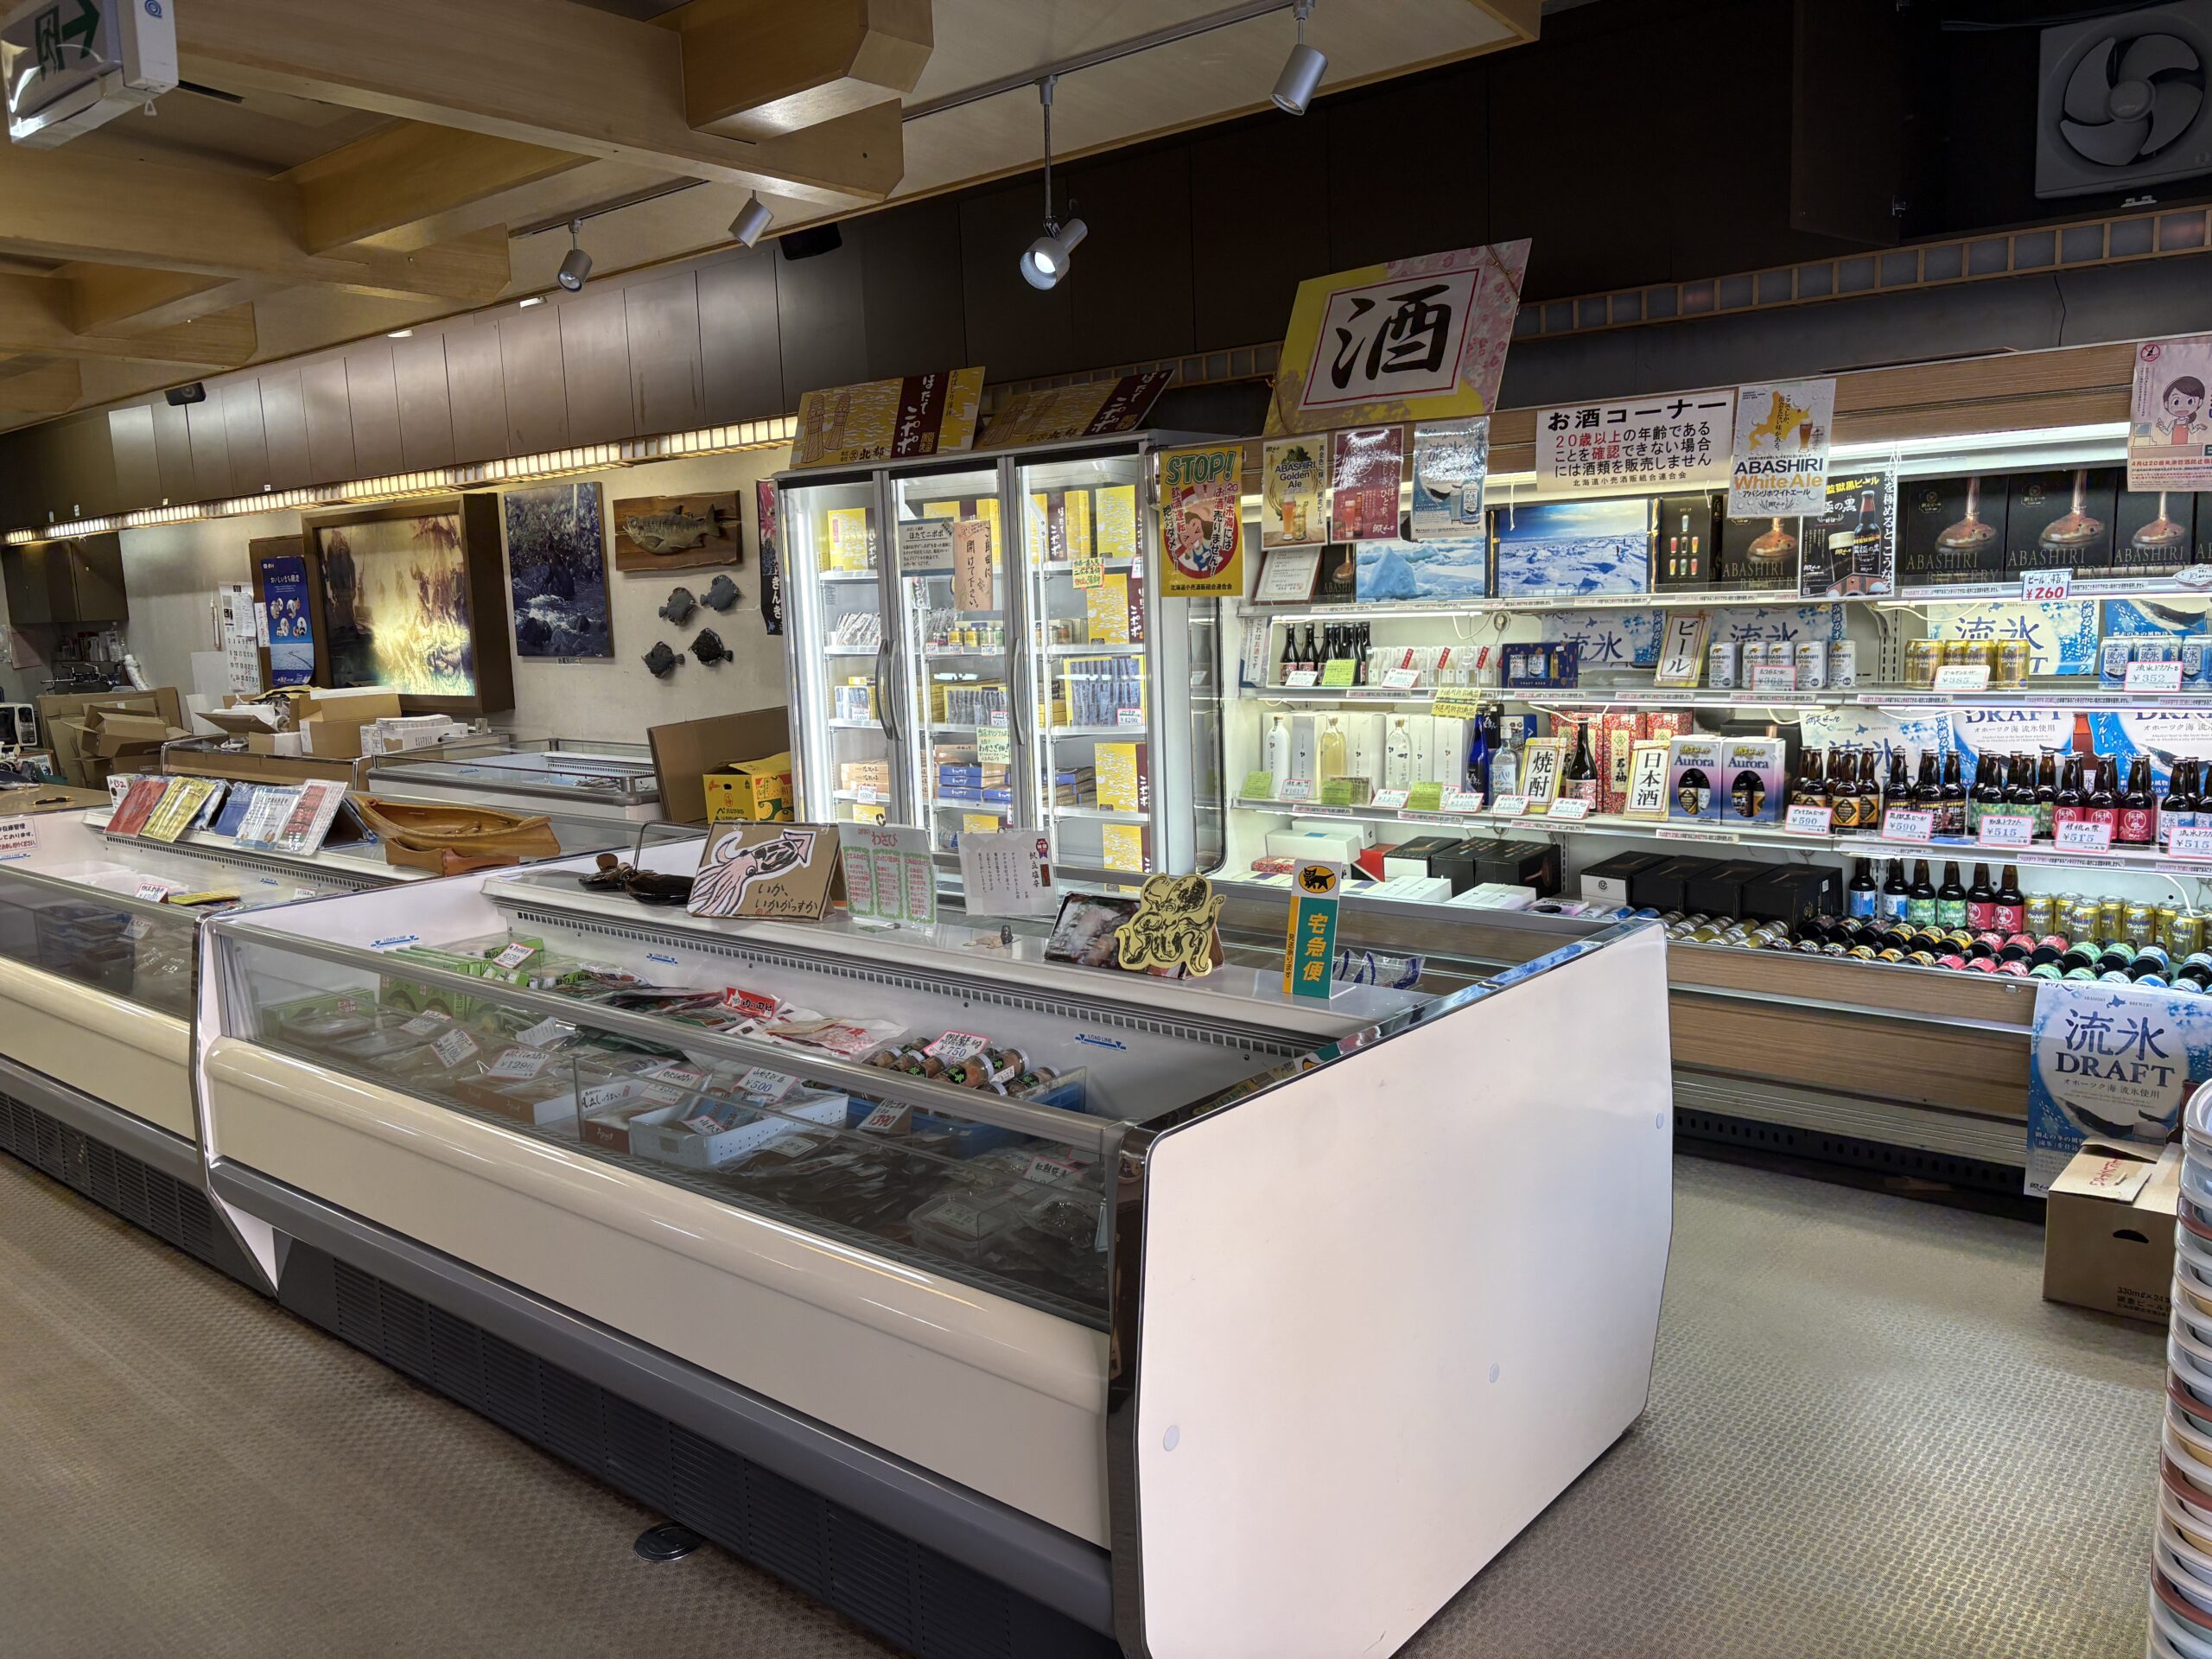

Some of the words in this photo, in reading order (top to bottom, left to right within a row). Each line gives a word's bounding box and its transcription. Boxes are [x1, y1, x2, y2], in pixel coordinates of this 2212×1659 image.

[1331, 283, 1452, 389] 酒
[920, 373, 935, 415] ほたて
[1548, 399, 1726, 431] お酒コーナー
[897, 406, 921, 455] ニポポ
[1555, 437, 1711, 462] ことを確認できない場合
[1166, 451, 1236, 484] STOP!
[1275, 461, 1315, 474] ABASHIRI
[1555, 453, 1712, 478] には酒類を販売しません
[1734, 458, 1823, 474] ABASHIRI
[1280, 472, 1310, 481] Golden
[1573, 472, 1687, 486] 北海道小売酒販組合連合会
[1734, 475, 1788, 490] White
[1789, 472, 1823, 487] Ale
[1743, 489, 1811, 499] アバシリホワイトエール
[1171, 487, 1186, 532] 飲酒運転
[1222, 483, 1238, 551] 20歳未満には
[1906, 552, 1978, 570] ABASHIRI
[2008, 548, 2085, 567] ABASHIRI
[2115, 546, 2184, 563] ABASHIRI
[1724, 561, 1783, 577] ABASHIRI
[2026, 587, 2064, 600] ¥260
[1955, 615, 2044, 651] 流氷
[1667, 620, 1699, 674] ビール
[2133, 674, 2165, 683] ¥352
[1974, 725, 2019, 734] オホーツク海
[1674, 755, 1715, 767] Aurora
[1727, 756, 1770, 769] Aurora
[1529, 751, 1554, 798] 焼酎
[1637, 752, 1662, 807] 日本酒
[1890, 823, 1916, 831] ¥590
[1987, 828, 2017, 836] ¥515
[2063, 834, 2094, 842] ¥515
[2176, 840, 2209, 849] ¥515
[758, 883, 788, 897] いか、
[755, 899, 818, 914] いかがっすか
[1303, 913, 1328, 982] 宅急便
[2065, 1008, 2170, 1061] 流氷
[2055, 1051, 2176, 1088] DRAFT
[745, 1080, 772, 1092] ¥500
[2063, 1079, 2116, 1093] オホーツク海
[2120, 1086, 2160, 1099] 流氷使用
